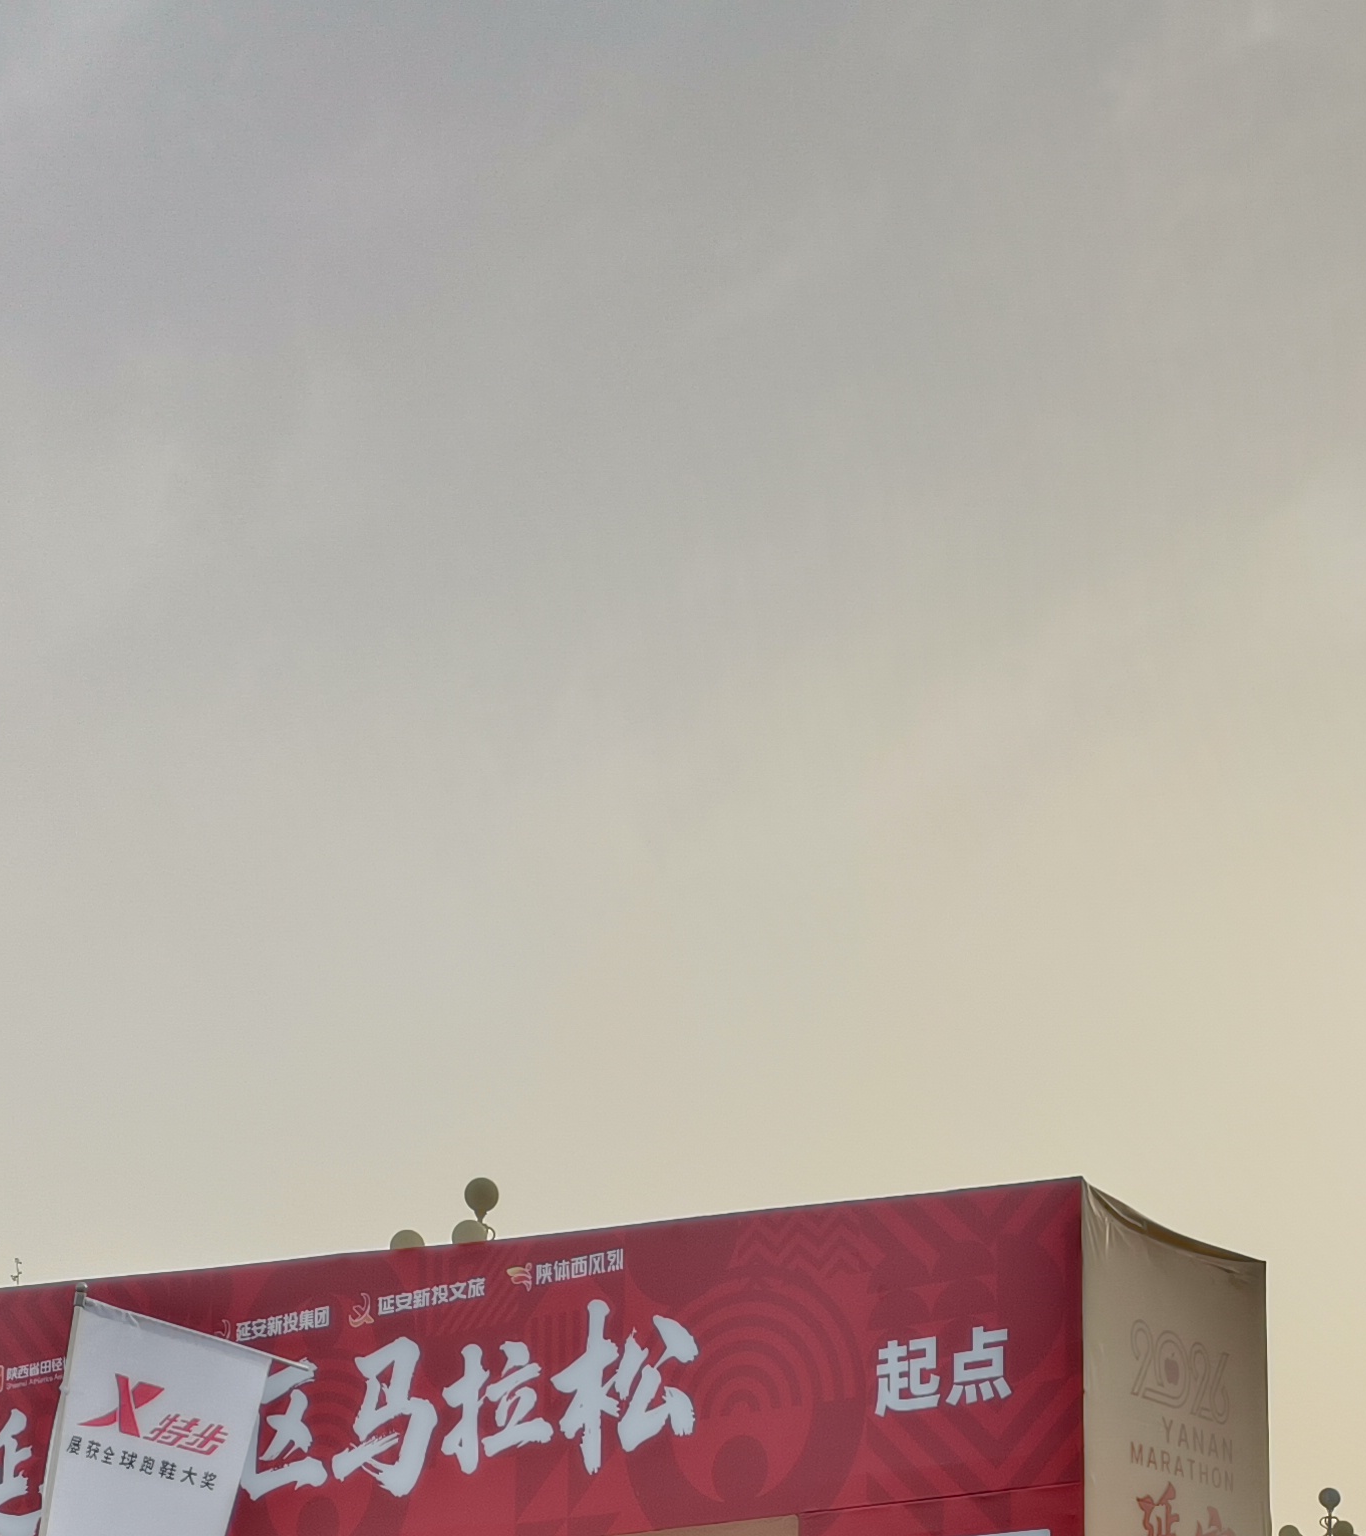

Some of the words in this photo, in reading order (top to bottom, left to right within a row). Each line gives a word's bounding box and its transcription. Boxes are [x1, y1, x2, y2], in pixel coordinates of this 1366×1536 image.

[535, 1248, 625, 1286] 陕体西风烈
[377, 1278, 487, 1316] 延安新投文旅
[235, 1306, 331, 1342] 延安新投集团
[6, 1357, 67, 1381] 陕西省田径
[874, 1326, 1013, 1418] 起点
[1161, 1415, 1234, 1465] YANAN
[1130, 1440, 1235, 1493] MARATHON
